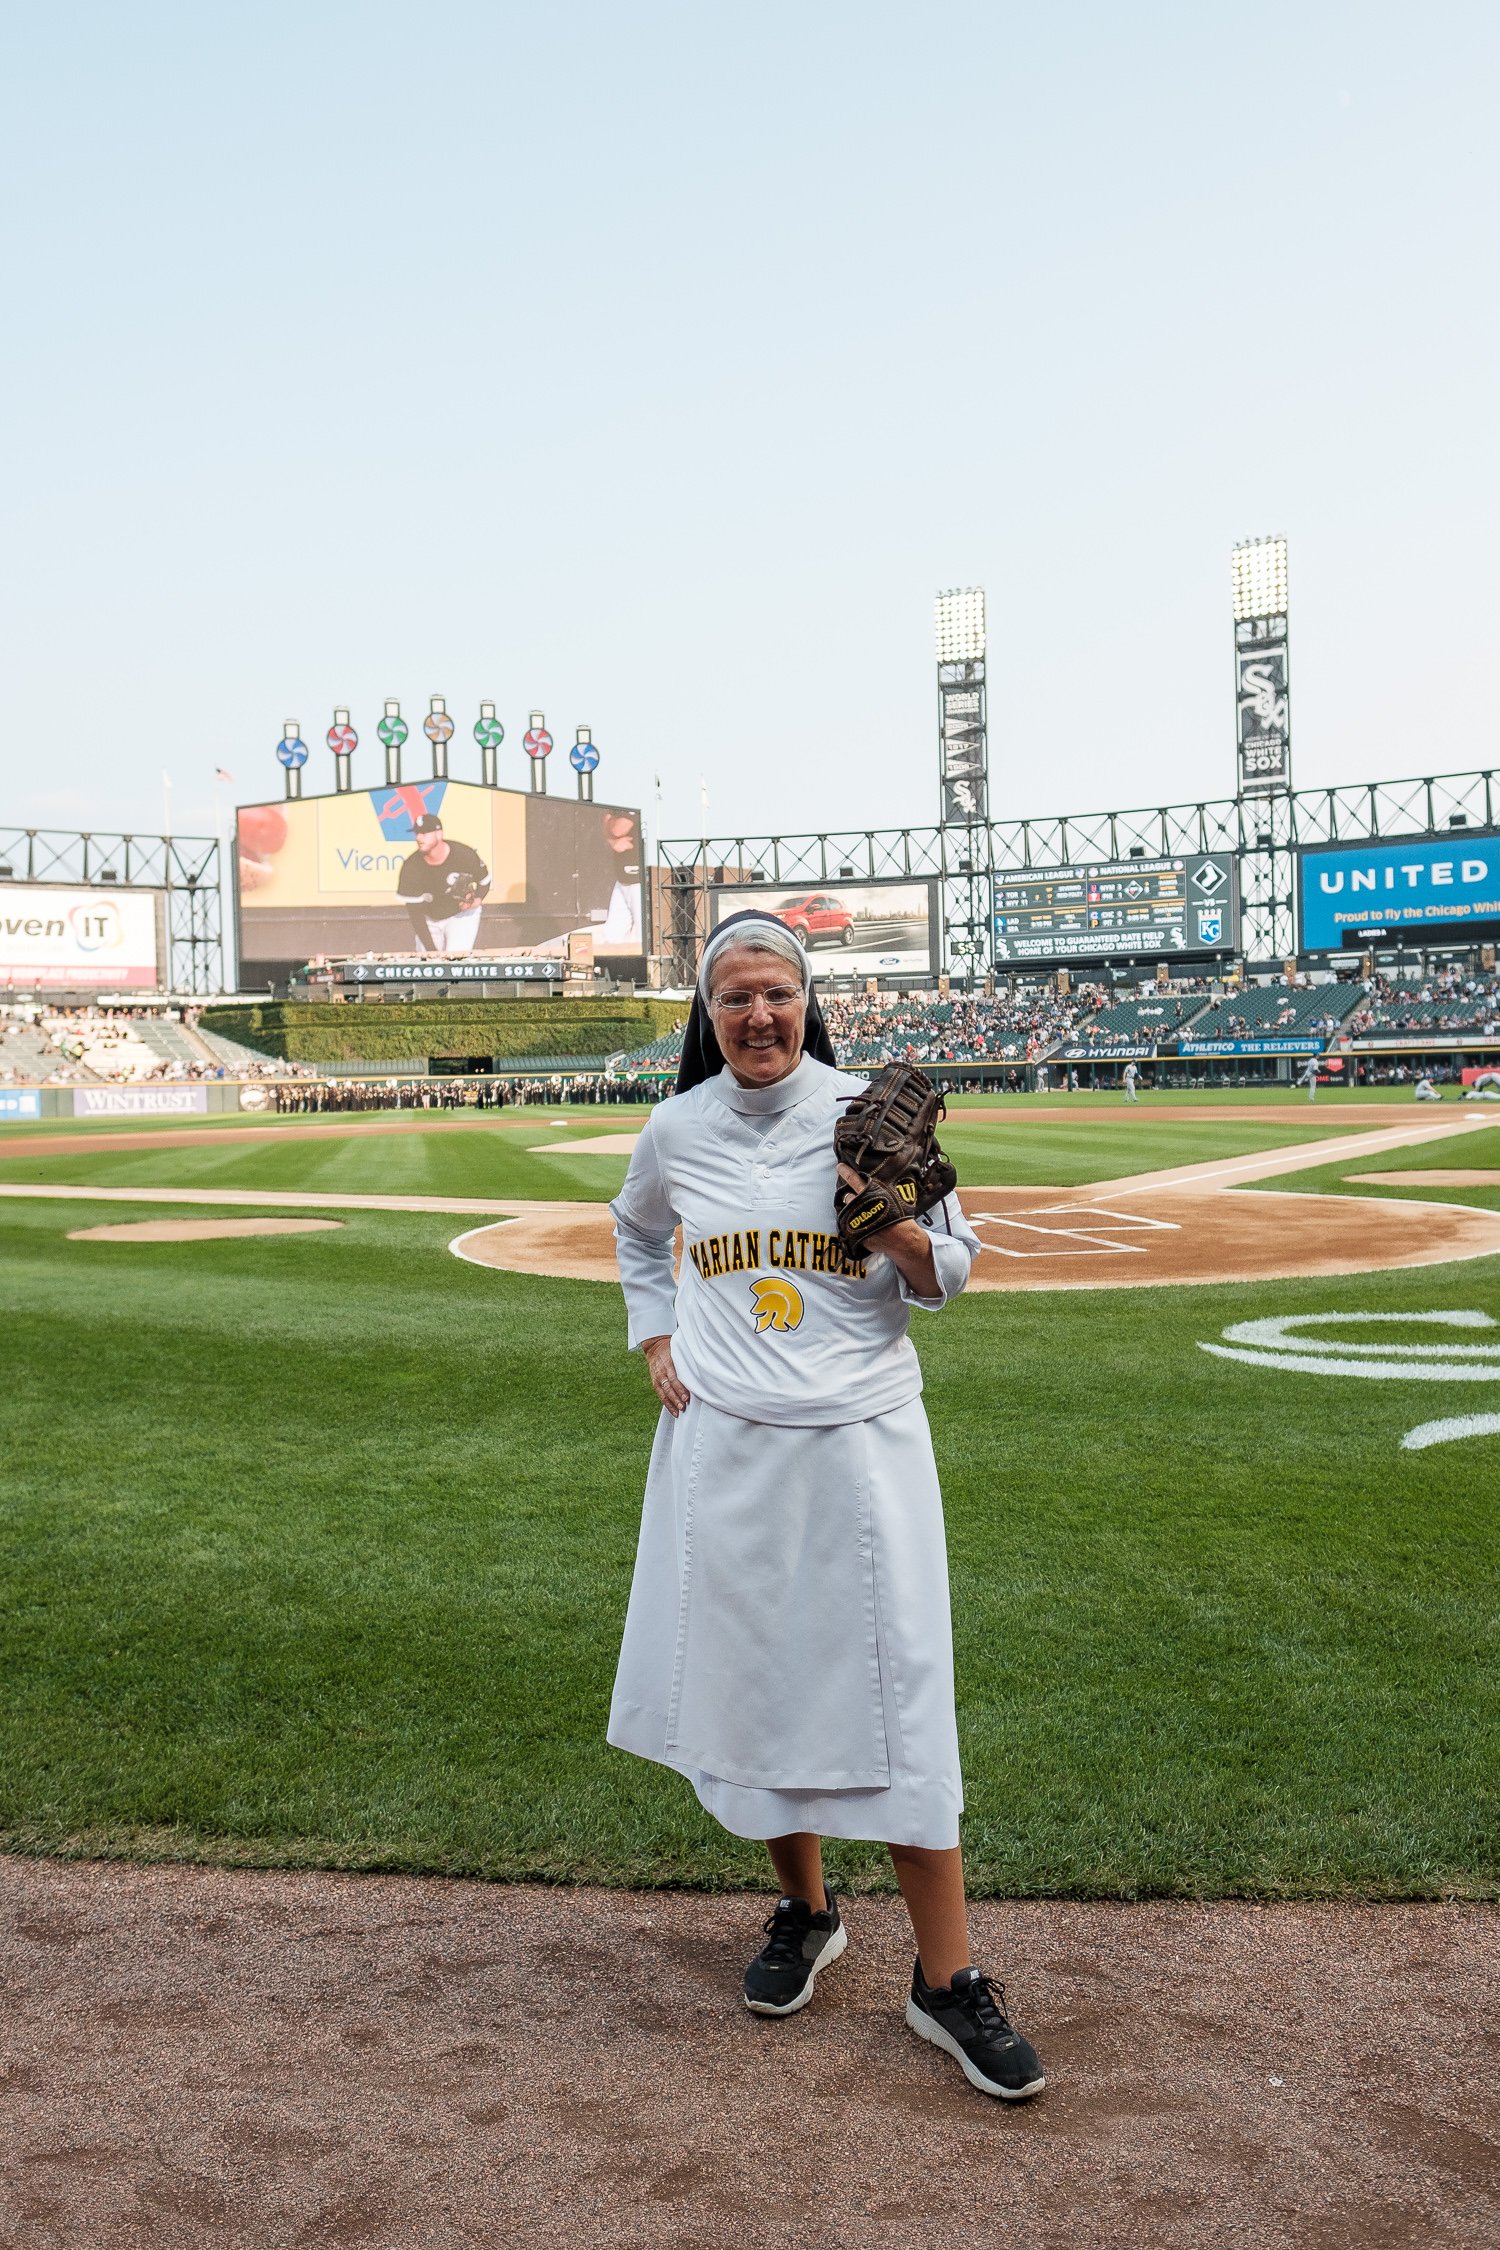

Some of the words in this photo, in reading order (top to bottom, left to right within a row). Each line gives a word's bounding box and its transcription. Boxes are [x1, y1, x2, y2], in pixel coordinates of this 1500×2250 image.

[945, 692, 979, 702] WORLD
[945, 699, 979, 710] SERIES
[1244, 738, 1282, 749] CHICAGO
[1244, 746, 1282, 758] WHITE
[1245, 754, 1282, 772] SOX
[1099, 864, 1140, 875] NATIONAL
[1140, 861, 1172, 872] LEAGUE
[1004, 872, 1043, 883] AMERICAN
[1044, 870, 1074, 880] LEAGUE
[1319, 859, 1489, 894] UNITED
[1333, 911, 1368, 924] Proud
[1370, 910, 1383, 921] to
[1385, 908, 1401, 921] fly
[1403, 906, 1423, 918] the
[1425, 903, 1470, 918] Chicago
[0, 918, 65, 937] ven
[85, 916, 108, 937] IT
[1013, 937, 1053, 949] WELCOME
[1054, 937, 1066, 946] TO
[1067, 934, 1120, 946] GUARANTEED
[1121, 933, 1141, 942] RATE
[1142, 931, 1165, 941] FIELD
[1017, 946, 1042, 957] HOME
[1043, 946, 1055, 955] OF
[1055, 944, 1078, 954] YOUR
[1078, 942, 1115, 953] CHICAGO
[1116, 940, 1142, 950] WHITE
[1143, 939, 1162, 949] SOX
[375, 966, 445, 978] CHICAGO
[451, 966, 498, 978] WHITE
[504, 965, 534, 977] SOX
[1088, 1047, 1150, 1059] HYUNDAI
[1182, 1042, 1235, 1053] ATHLETICO
[1241, 1043, 1262, 1053] THE
[1263, 1041, 1320, 1052] RELIEVERS
[83, 1089, 197, 1109] WINTRUST
[896, 1182, 916, 1204] W
[849, 1200, 885, 1230] Wilson
